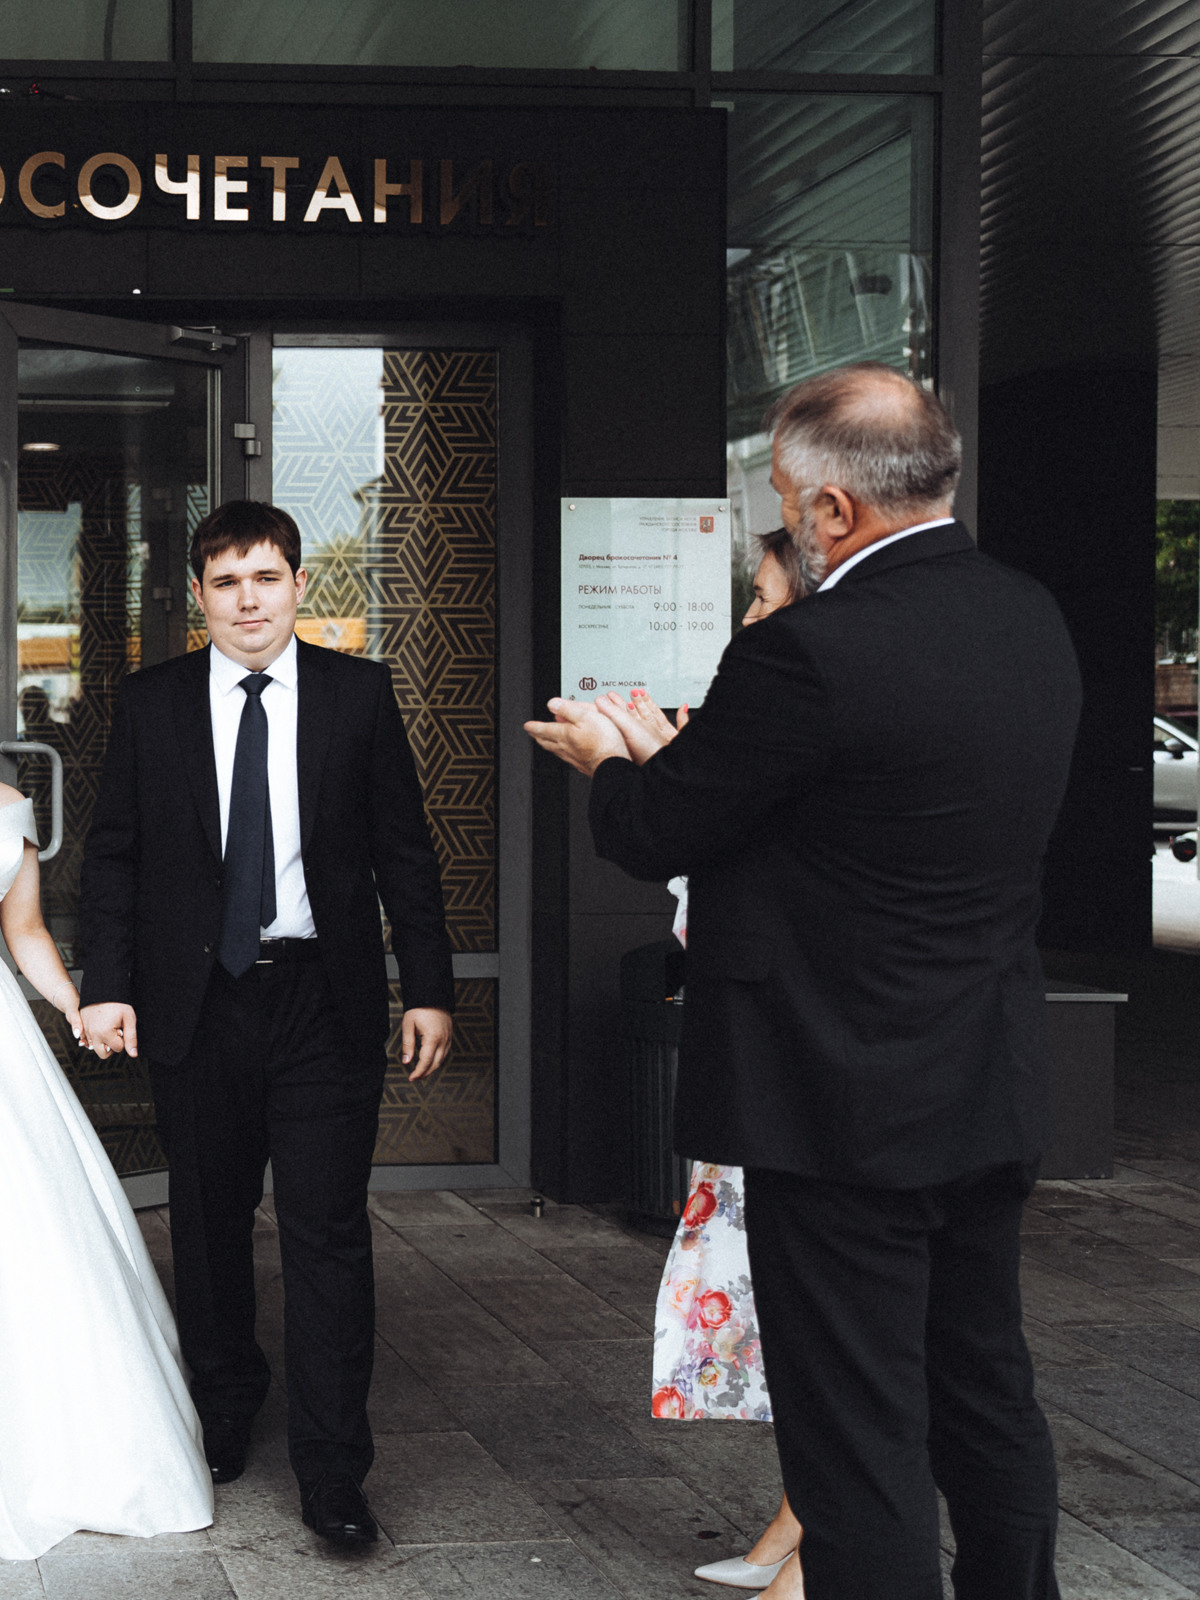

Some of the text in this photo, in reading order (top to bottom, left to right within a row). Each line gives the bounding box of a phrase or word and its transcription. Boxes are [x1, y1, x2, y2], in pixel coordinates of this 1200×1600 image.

[579, 553, 605, 562] Дворец
[606, 553, 661, 562] бракосочетания
[578, 585, 662, 595] РЕЖИМ РАБОТЫ
[653, 602, 677, 612] 9:00
[687, 602, 714, 613] 18:00
[649, 621, 677, 631] 10:00
[687, 621, 714, 631] 19:00
